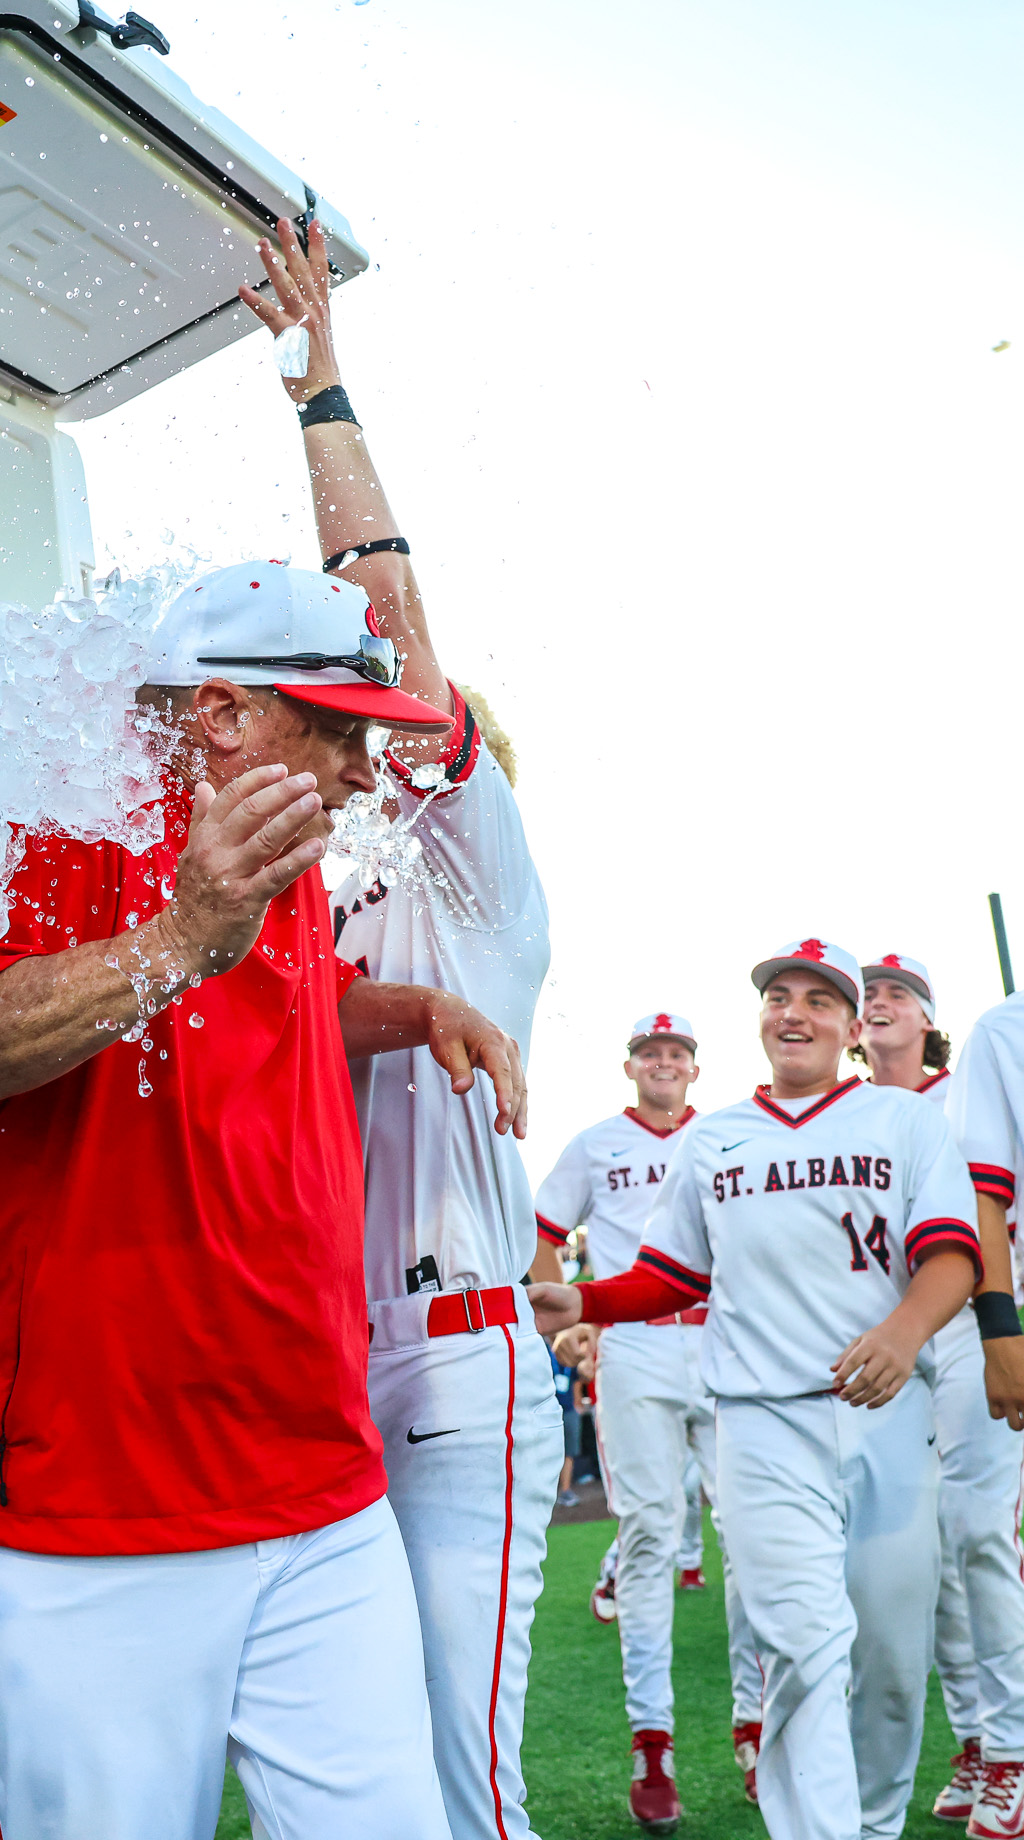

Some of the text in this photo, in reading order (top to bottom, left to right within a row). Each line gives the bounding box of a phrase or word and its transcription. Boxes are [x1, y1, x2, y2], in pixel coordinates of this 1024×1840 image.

[607, 1167, 639, 1190] ST.
[713, 1155, 892, 1203] ST. ALBANS
[840, 1211, 891, 1276] 14
